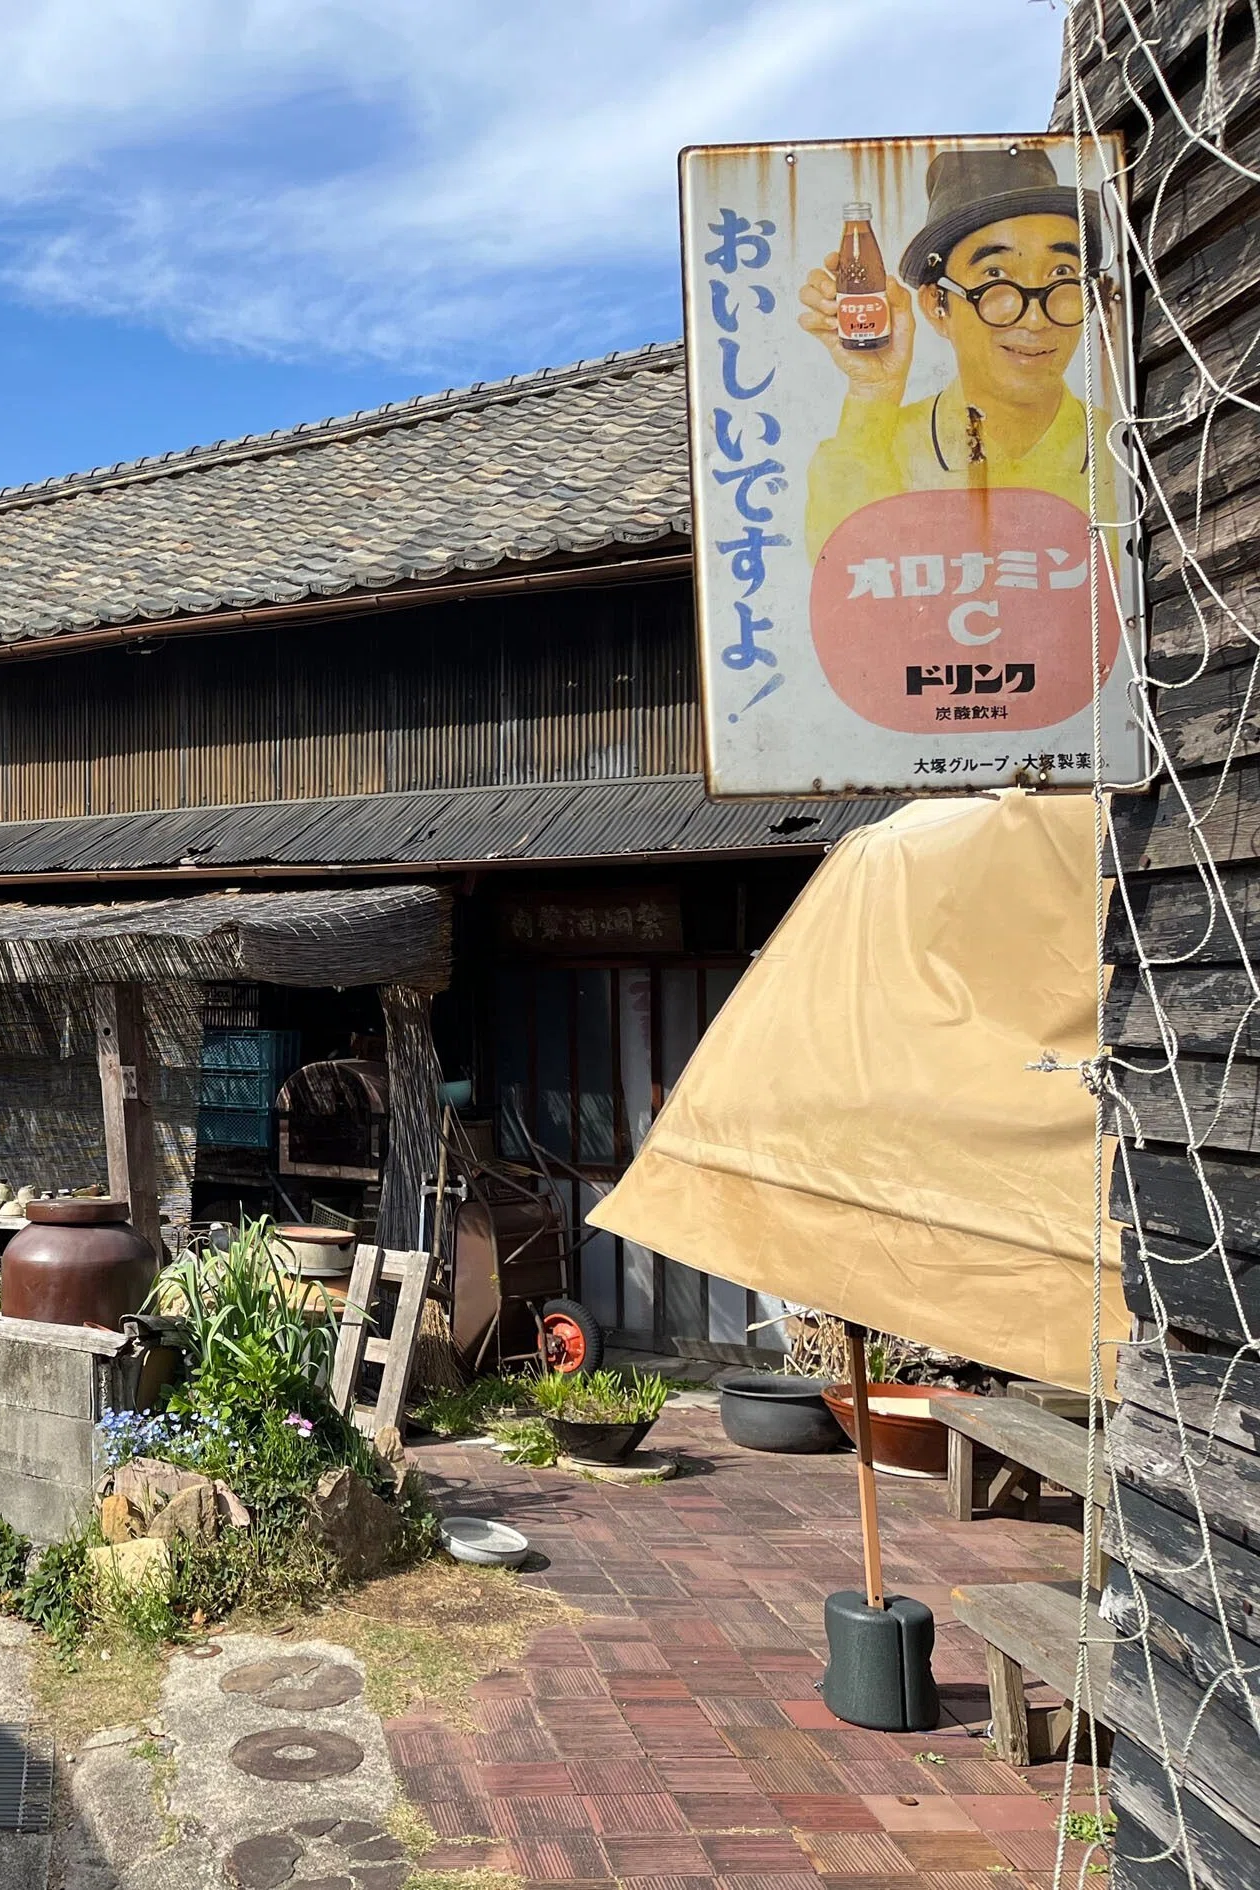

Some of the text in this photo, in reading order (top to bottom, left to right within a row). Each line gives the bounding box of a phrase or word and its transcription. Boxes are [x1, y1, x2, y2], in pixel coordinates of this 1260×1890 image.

[840, 302, 883, 313] オロナミン
[856, 313, 868, 323] C
[847, 548, 1088, 599] オロナミン
[947, 600, 1002, 646] C
[906, 663, 1035, 696] ドリンク
[935, 705, 1009, 721] 炭酸飲料
